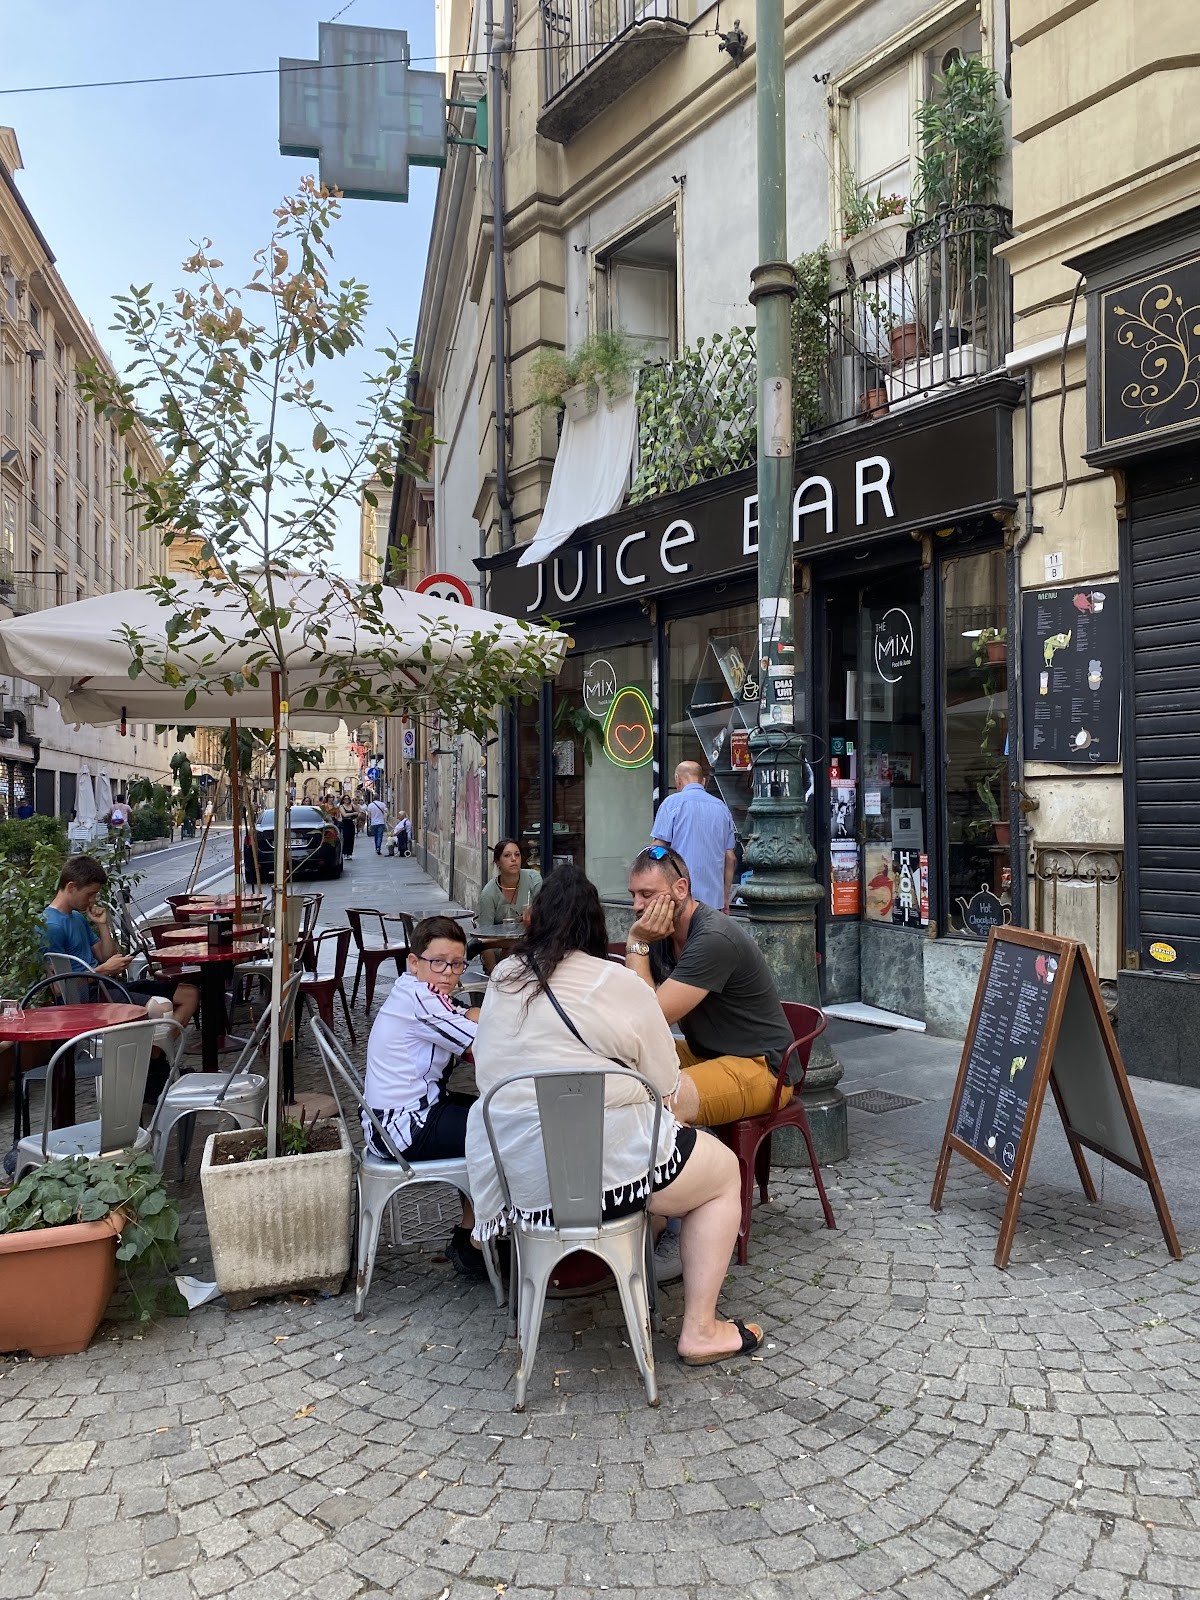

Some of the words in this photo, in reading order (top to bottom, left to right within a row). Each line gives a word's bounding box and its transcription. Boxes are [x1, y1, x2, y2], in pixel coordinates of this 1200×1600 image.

[1049, 554, 1059, 565] 11
[875, 621, 887, 633] THE
[979, 902, 993, 913] Hot
